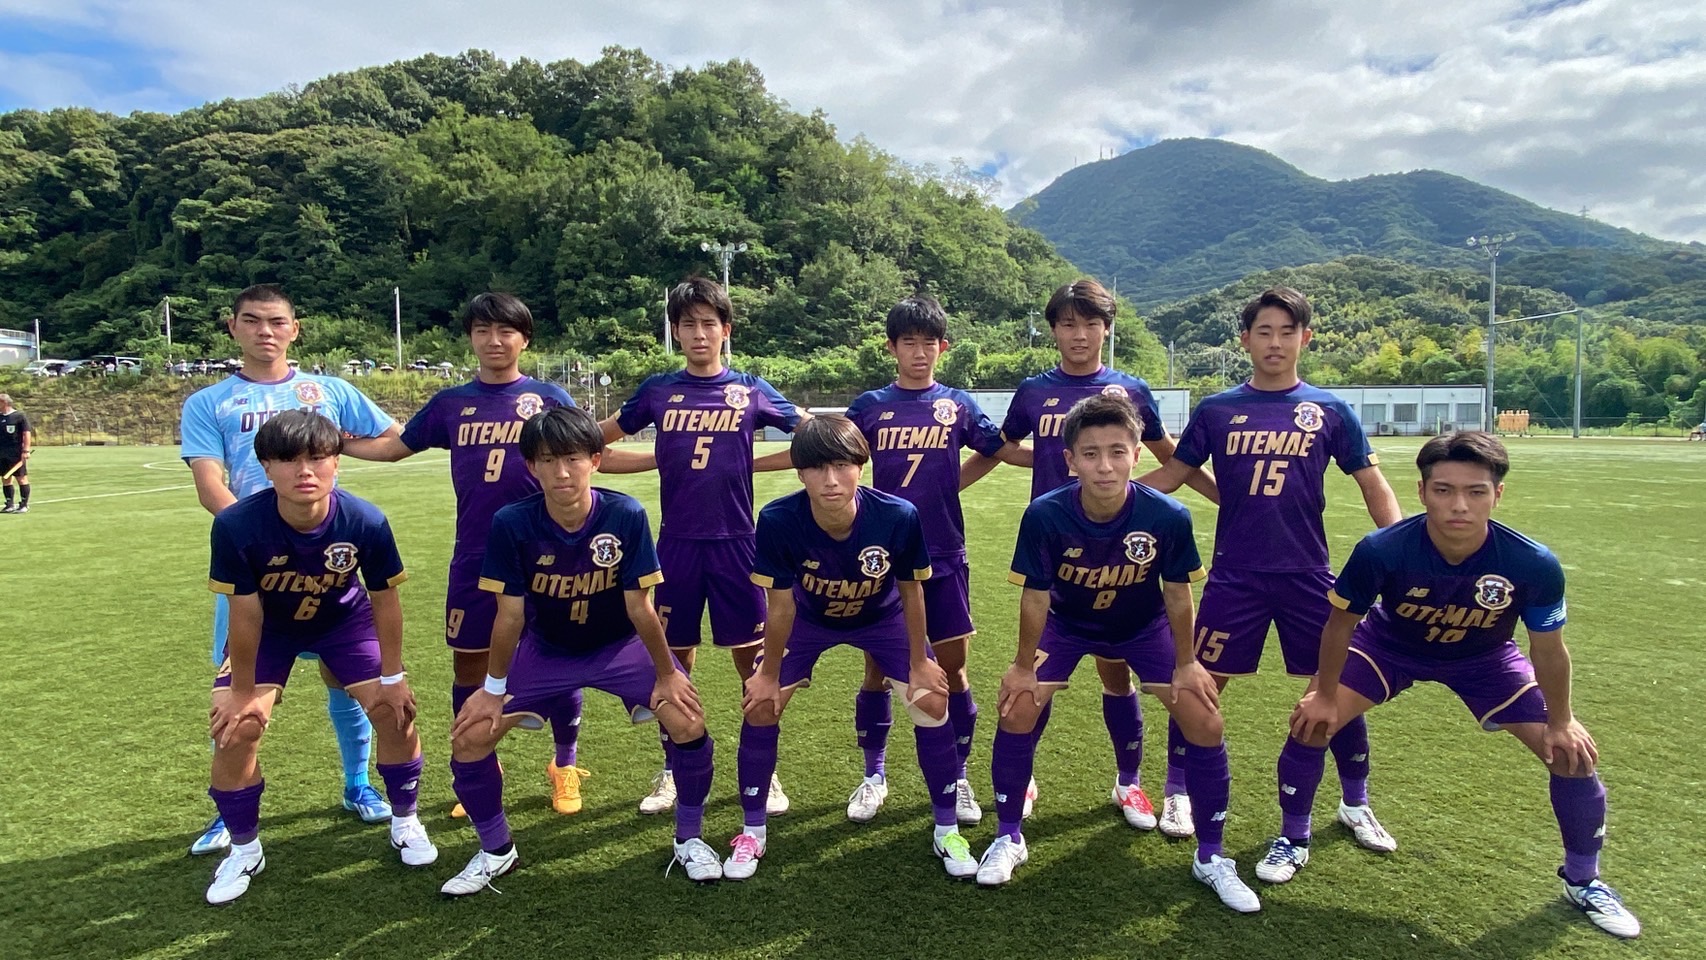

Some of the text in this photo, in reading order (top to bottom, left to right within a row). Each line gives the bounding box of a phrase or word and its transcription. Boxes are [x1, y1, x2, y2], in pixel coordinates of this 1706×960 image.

[458, 421, 525, 446] OTEMA
[662, 409, 745, 432] OTEMAE
[877, 426, 952, 451] OTEMAE
[1226, 431, 1317, 457] OTEMAE
[484, 448, 506, 483] 9
[691, 436, 714, 470] 5
[901, 453, 925, 488] 7
[1249, 460, 1289, 496] 15
[531, 566, 620, 598] OTEMAE
[802, 573, 886, 600] OTEMAE
[1057, 563, 1152, 589] OTEMAE
[294, 596, 321, 620] 6
[570, 600, 589, 624] 4
[824, 600, 864, 617] 26
[1092, 590, 1117, 610] 8
[447, 608, 465, 639] 9
[1425, 626, 1467, 643] 10
[1194, 626, 1230, 663] 15
